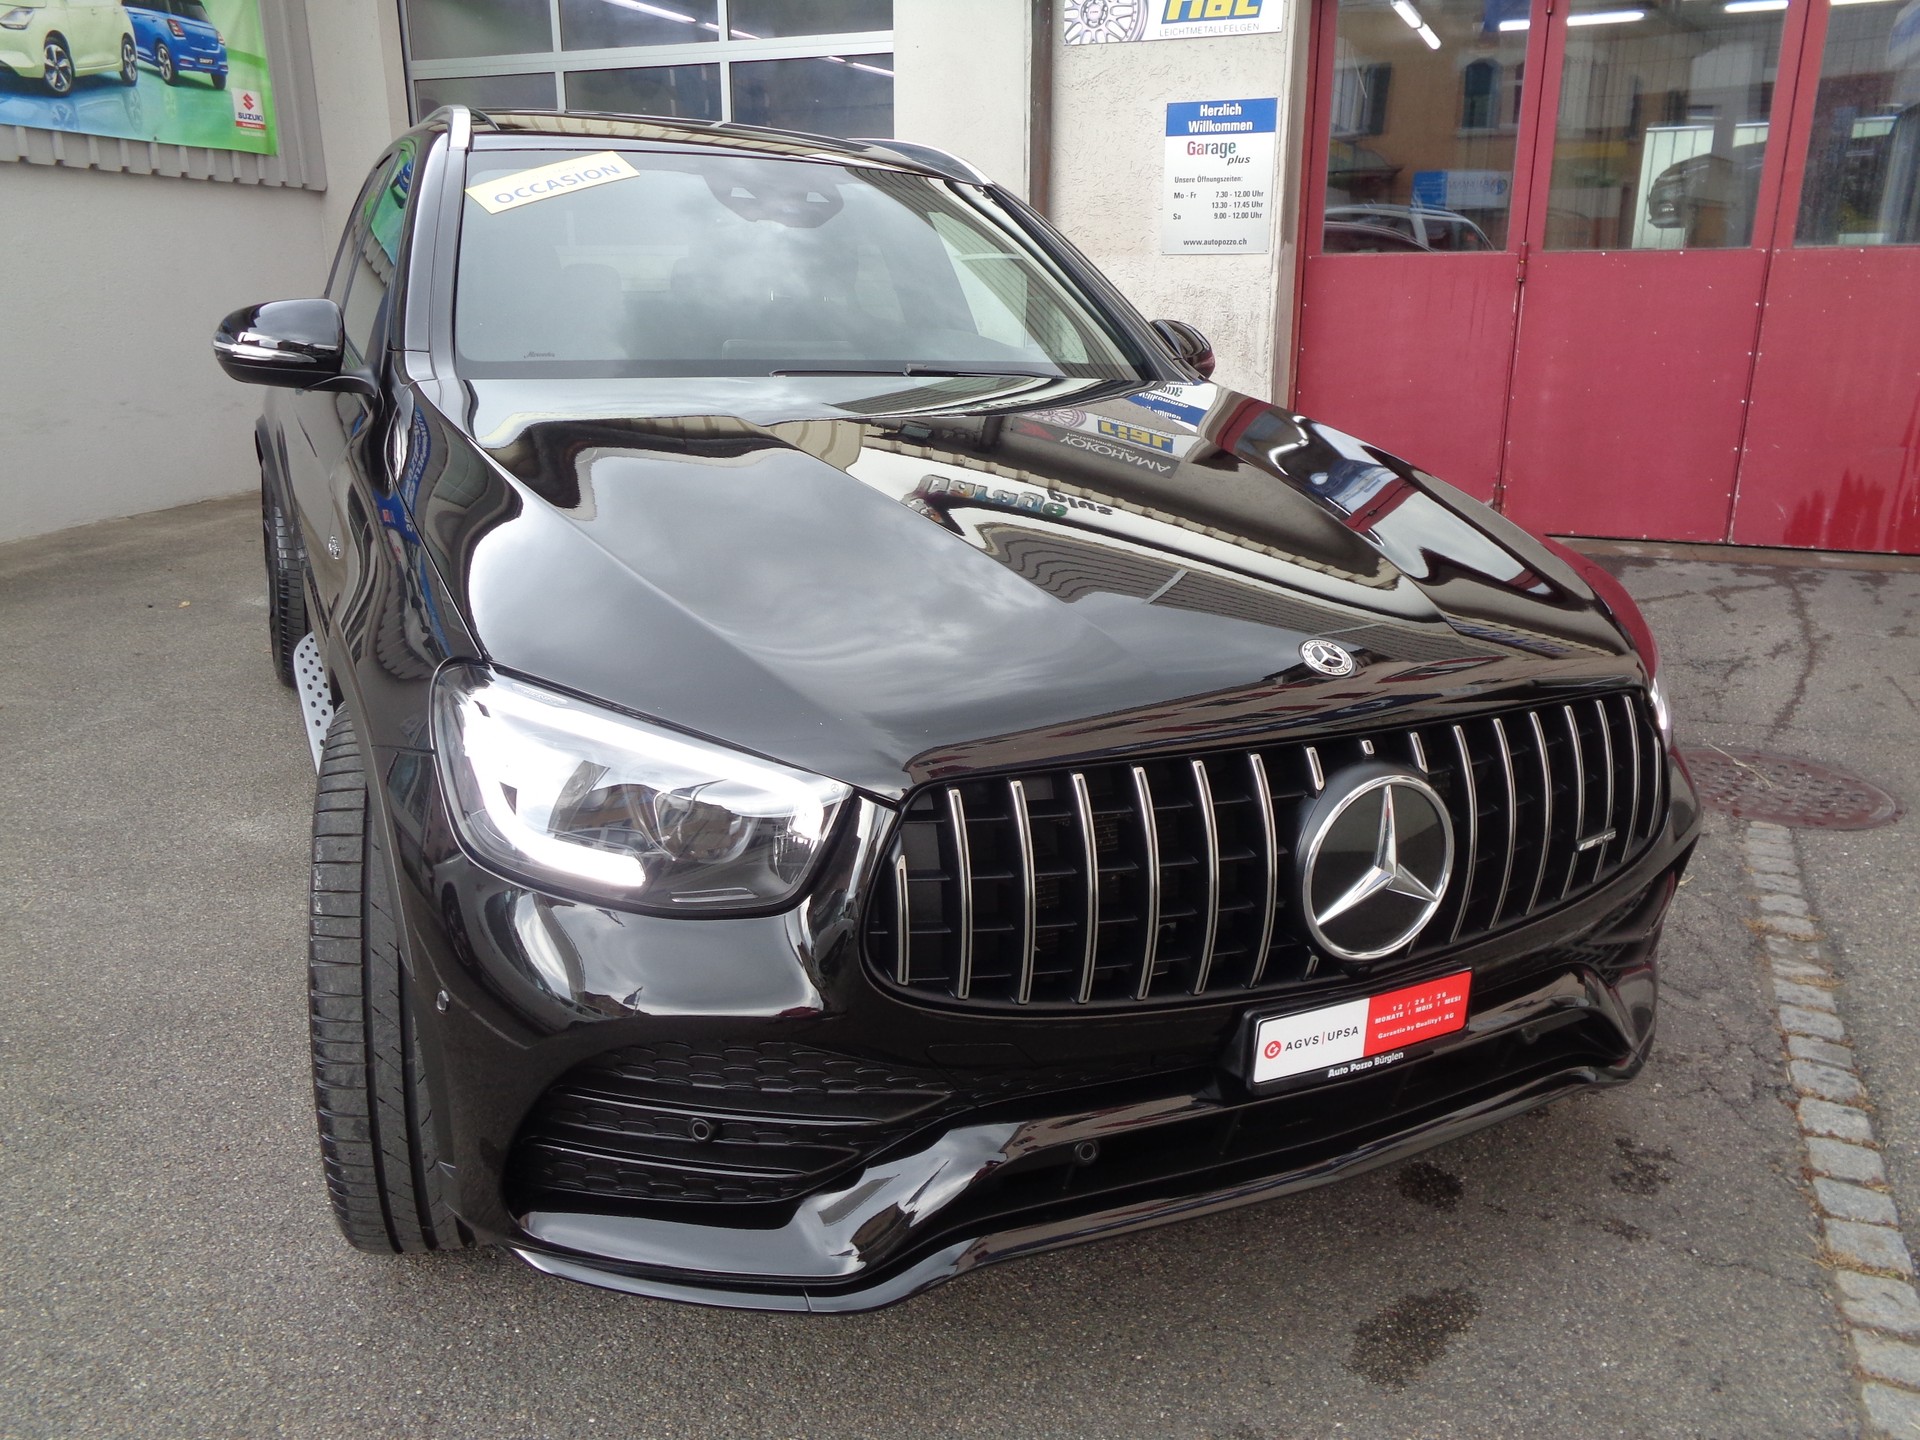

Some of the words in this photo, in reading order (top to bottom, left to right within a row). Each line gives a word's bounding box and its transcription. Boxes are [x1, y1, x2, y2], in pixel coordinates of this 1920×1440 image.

[1159, 23, 1260, 37] LEICHTMETALLFELGEN
[1200, 103, 1242, 117] Herzlich
[1188, 120, 1253, 133] Willkommen
[1187, 141, 1237, 159] Garage
[1227, 155, 1251, 166] plus
[494, 164, 621, 204] OCCASION
[1174, 176, 1196, 184] Unsere
[1190, 191, 1197, 199] Fr
[1234, 190, 1251, 198] 12.00
[1211, 201, 1228, 209] 13.30
[1251, 200, 1264, 208] Uhr
[1232, 211, 1249, 219] 12.00
[1250, 211, 1263, 219] Uhr
[1183, 238, 1248, 247] www.autopozzo.ch
[1374, 1011, 1405, 1024] MONATE
[1415, 1003, 1433, 1013] MOIS
[1444, 995, 1462, 1005] MESI
[1392, 1003, 1403, 1012] 12
[1443, 1012, 1455, 1020] AG
[1284, 1035, 1319, 1051] AGVS
[1327, 1026, 1359, 1041] UPSA
[1327, 1067, 1349, 1078] Auto
[1350, 1060, 1373, 1072] Pozzo
[1374, 1052, 1404, 1067] Bürglen
